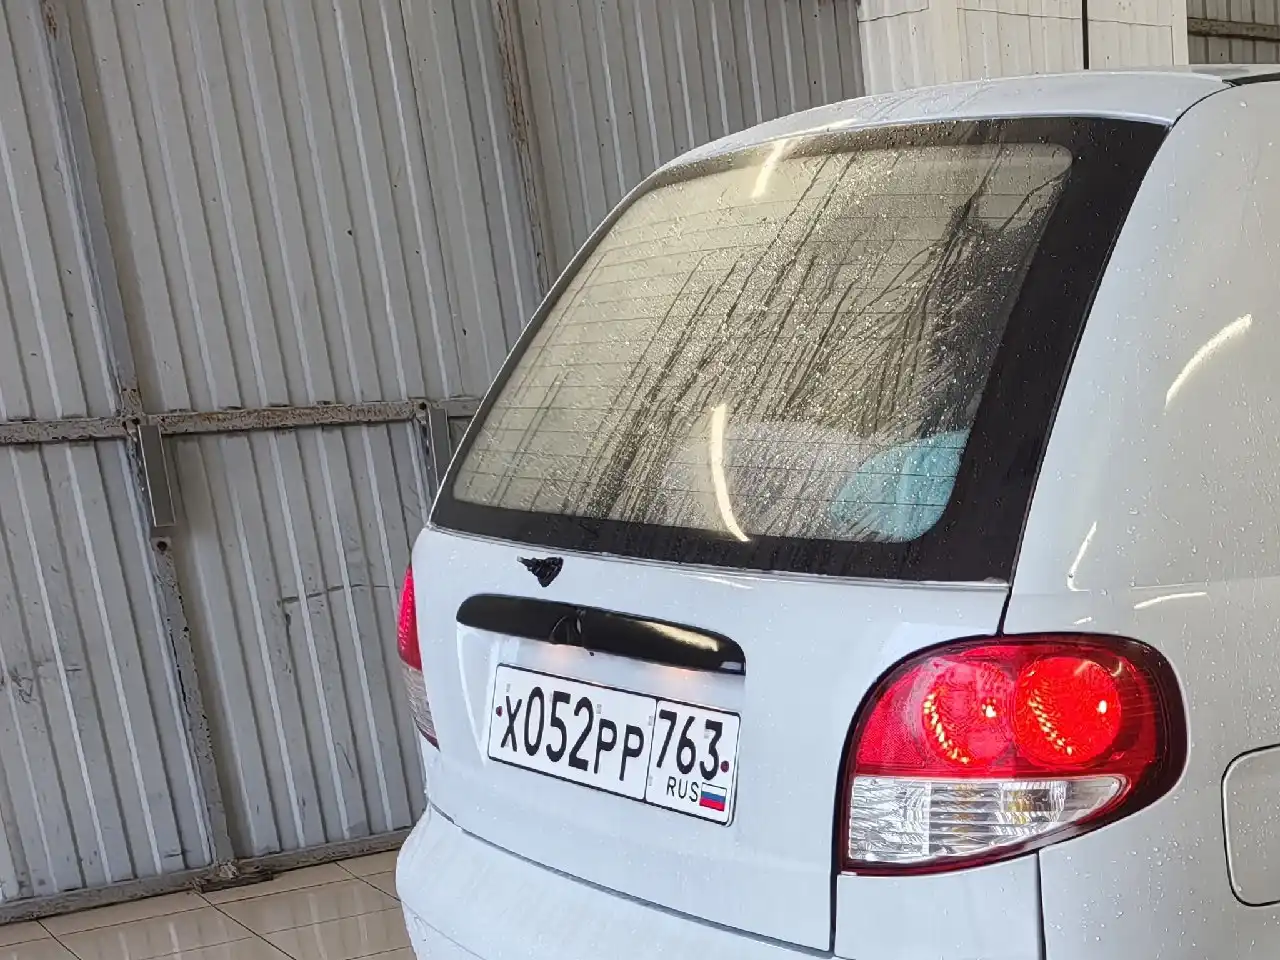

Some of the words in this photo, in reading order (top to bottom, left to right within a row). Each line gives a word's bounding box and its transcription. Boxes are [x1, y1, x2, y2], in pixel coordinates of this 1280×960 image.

[500, 686, 645, 781] Х052РР
[656, 709, 723, 781] 763
[666, 775, 700, 802] RUS
